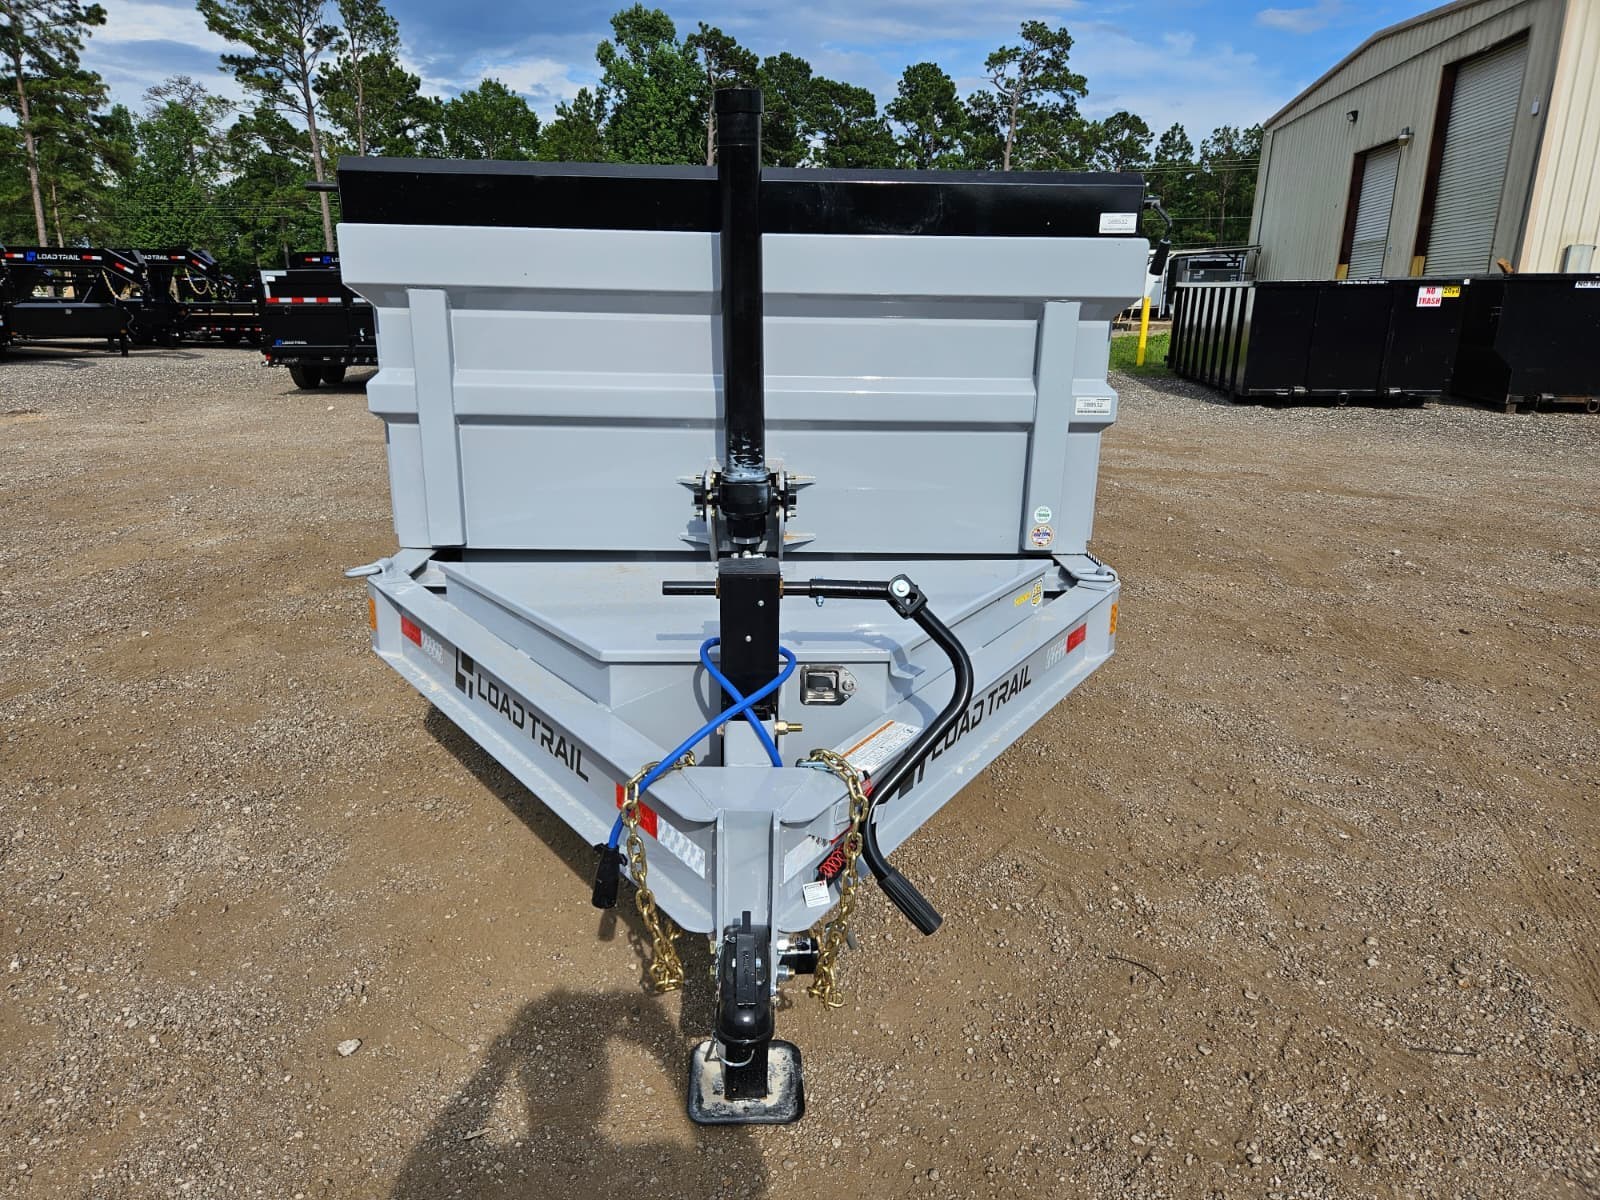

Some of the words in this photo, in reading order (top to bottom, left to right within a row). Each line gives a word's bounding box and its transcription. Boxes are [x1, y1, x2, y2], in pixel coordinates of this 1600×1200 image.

[1418, 297, 1441, 305] TRASH
[1426, 287, 1436, 295] NO
[987, 664, 1032, 716] TRAIL
[477, 672, 525, 730] LOAD
[528, 711, 589, 783] TRAIL
